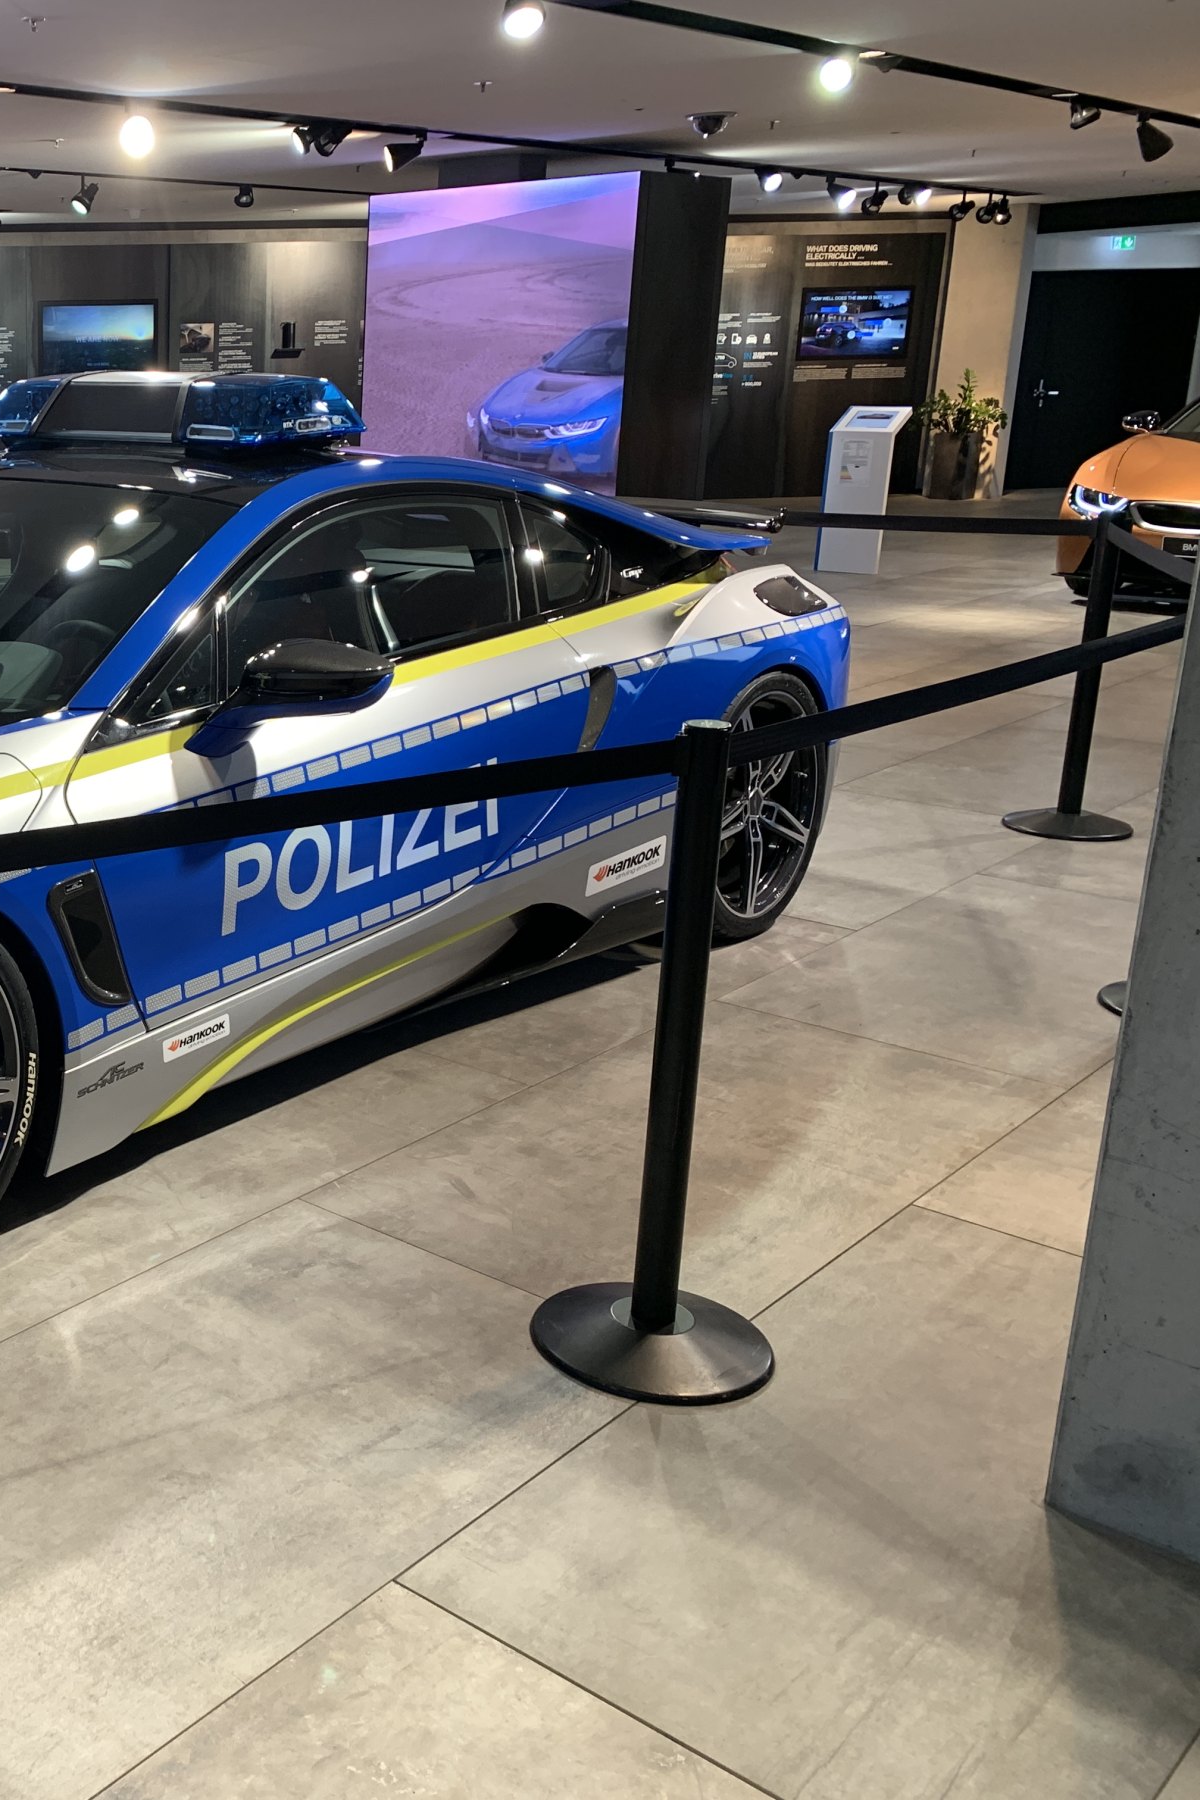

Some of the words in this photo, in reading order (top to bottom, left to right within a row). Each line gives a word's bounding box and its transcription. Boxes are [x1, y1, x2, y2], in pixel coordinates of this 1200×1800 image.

[805, 252, 857, 260] ELECTRICALLY
[806, 244, 828, 252] WHAT
[828, 244, 849, 252] DOES
[849, 244, 878, 252] DRIVING
[221, 757, 499, 936] POLIZEI
[76, 1062, 145, 1098] SCHNITZER
